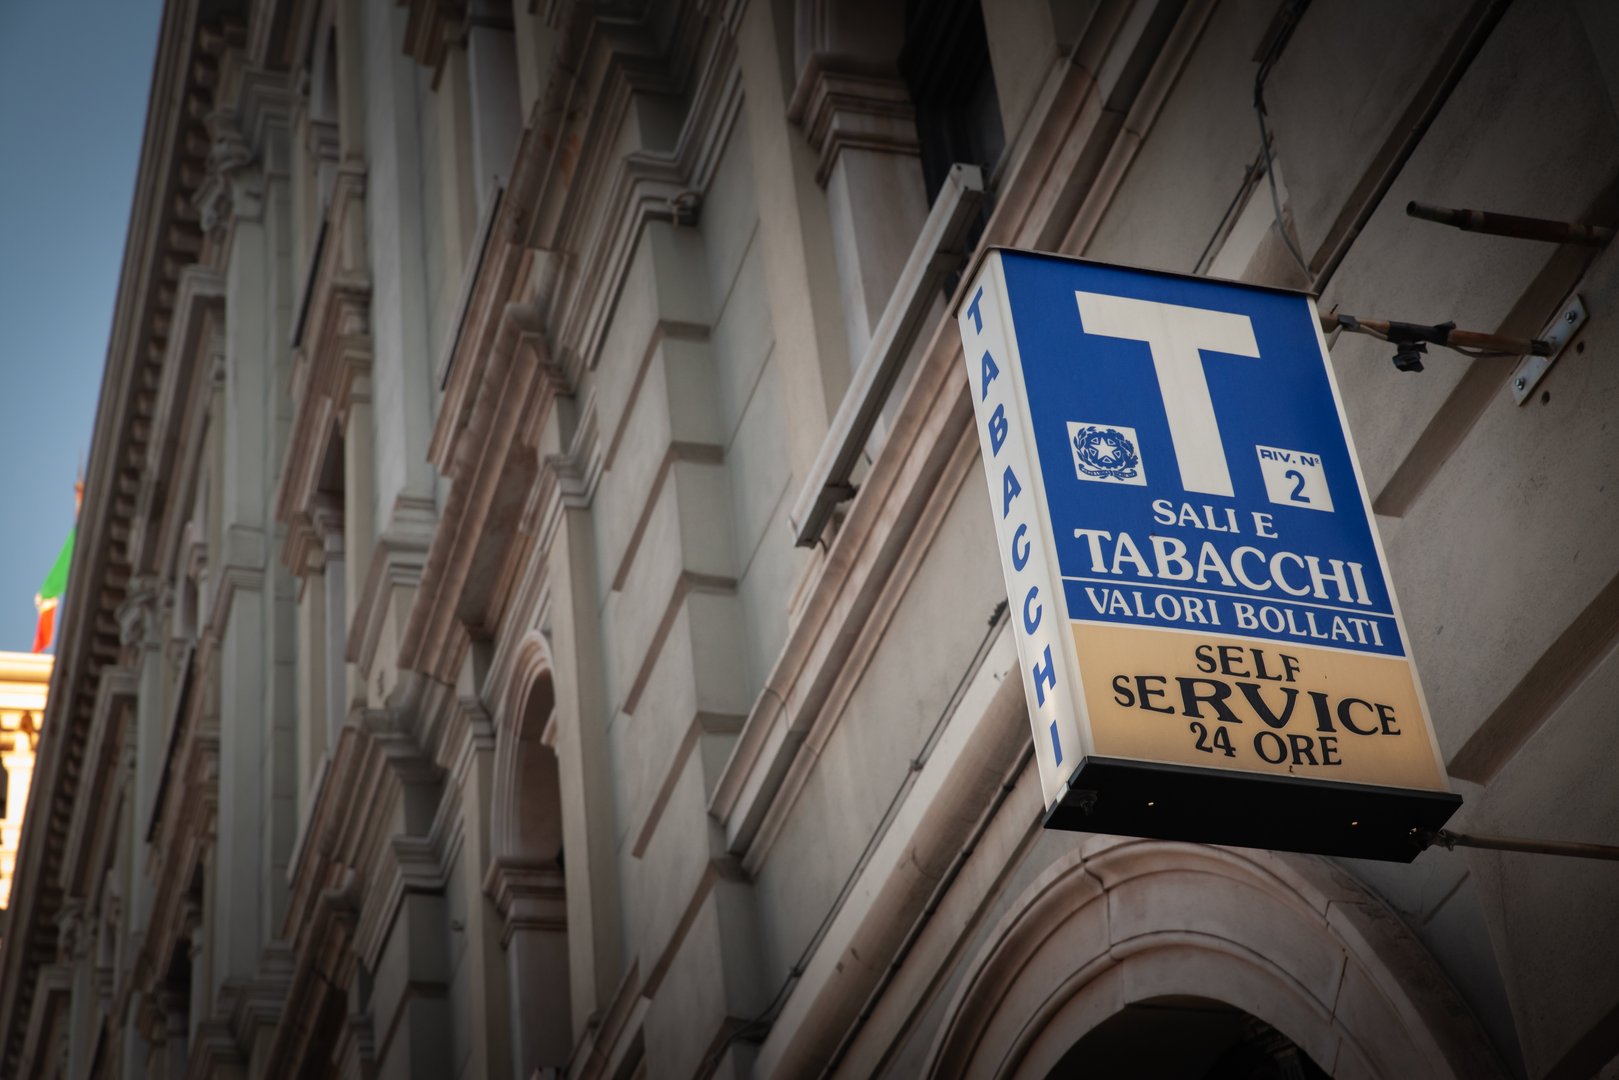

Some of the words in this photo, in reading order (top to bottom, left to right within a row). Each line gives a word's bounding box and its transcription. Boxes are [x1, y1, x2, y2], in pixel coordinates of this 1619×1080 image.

[1074, 290, 1260, 497] T
[1260, 449, 1297, 464] RIV.
[1285, 469, 1311, 503] 2
[967, 287, 1063, 768] TABACCHI
[1152, 499, 1240, 534] SALI
[1251, 512, 1279, 539] E
[1074, 528, 1373, 606] TABACCHI
[1084, 588, 1221, 625] VALORI
[1232, 602, 1384, 646] BOLLATI
[1195, 644, 1300, 682] SELF
[1113, 675, 1401, 736] SERVICE
[1190, 722, 1236, 758] 24
[1253, 731, 1342, 766] ORE
